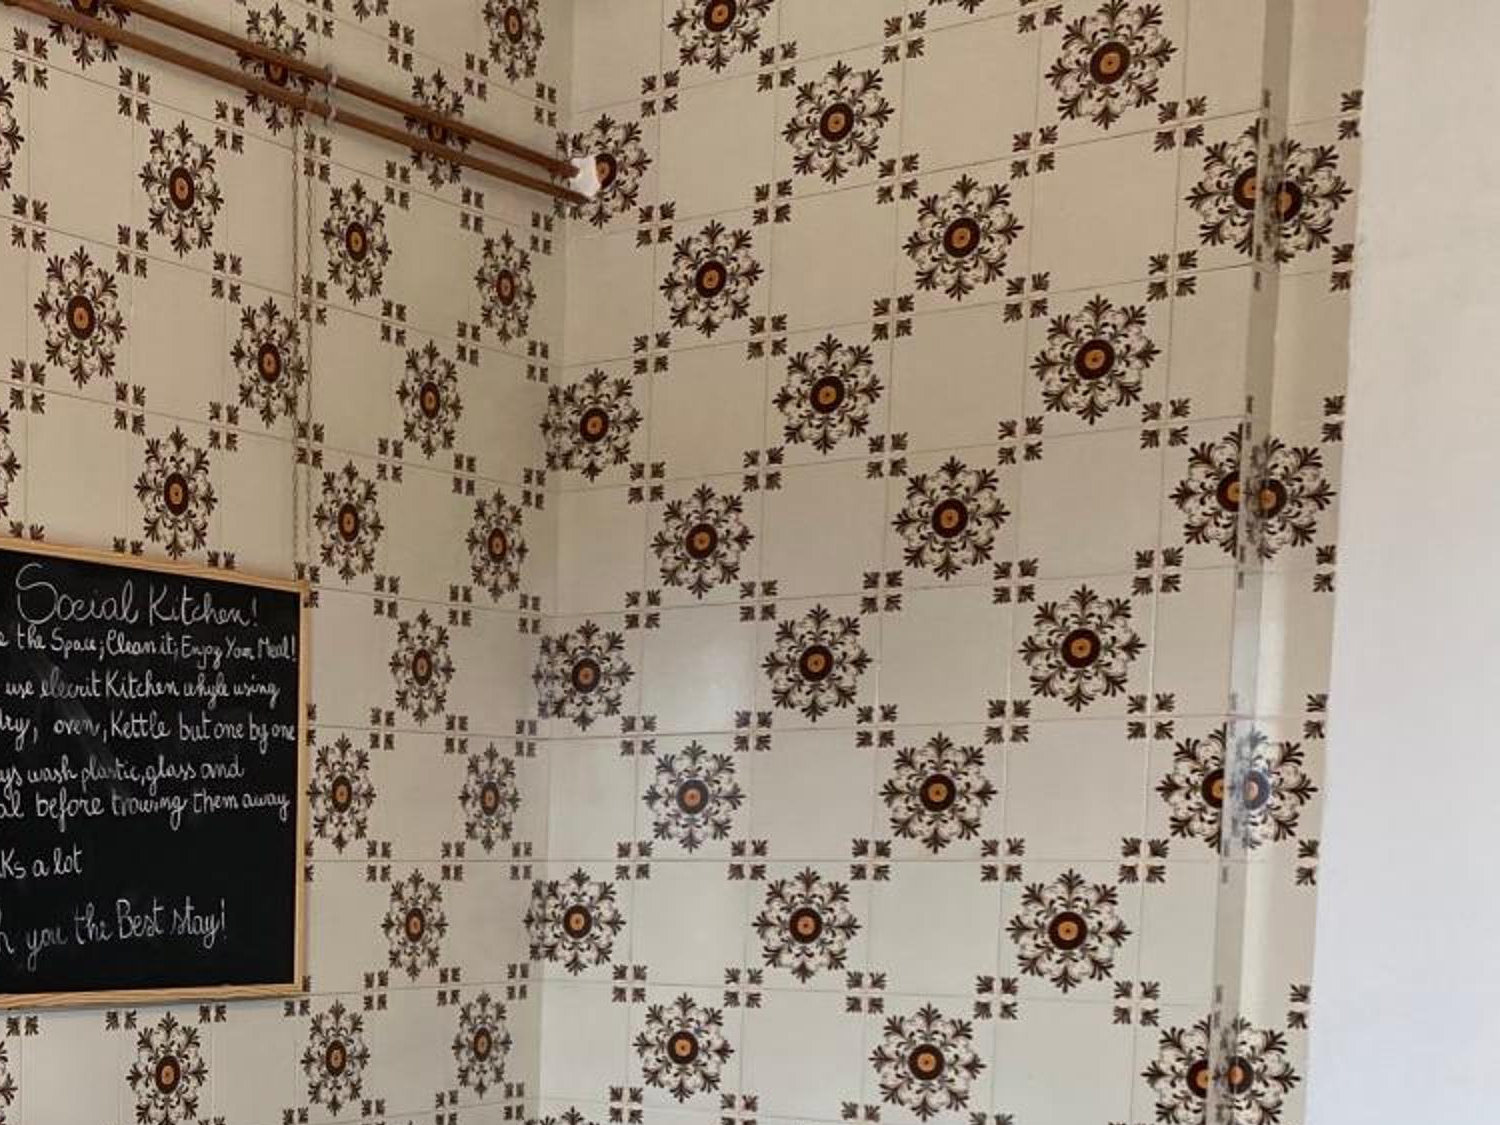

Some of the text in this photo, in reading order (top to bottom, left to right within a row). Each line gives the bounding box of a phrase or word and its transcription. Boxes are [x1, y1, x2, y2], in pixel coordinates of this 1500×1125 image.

[15, 562, 259, 628] Social Kitchen!
[16, 623, 46, 649] the
[106, 629, 156, 655] Clean
[181, 635, 223, 670] Enjoy
[5, 680, 35, 699] use
[105, 669, 180, 699] Kitchen
[233, 674, 281, 710] using
[179, 710, 212, 742] but
[213, 723, 245, 740] one
[249, 712, 269, 755] by
[271, 723, 295, 741] one
[27, 754, 78, 784] wash
[200, 754, 245, 780] and
[36, 786, 105, 833] before
[192, 788, 239, 815] them
[242, 793, 290, 823] away
[32, 859, 50, 878] a
[53, 842, 83, 876] lot
[26, 927, 68, 973] you
[73, 902, 113, 945] the
[116, 896, 165, 940] Best
